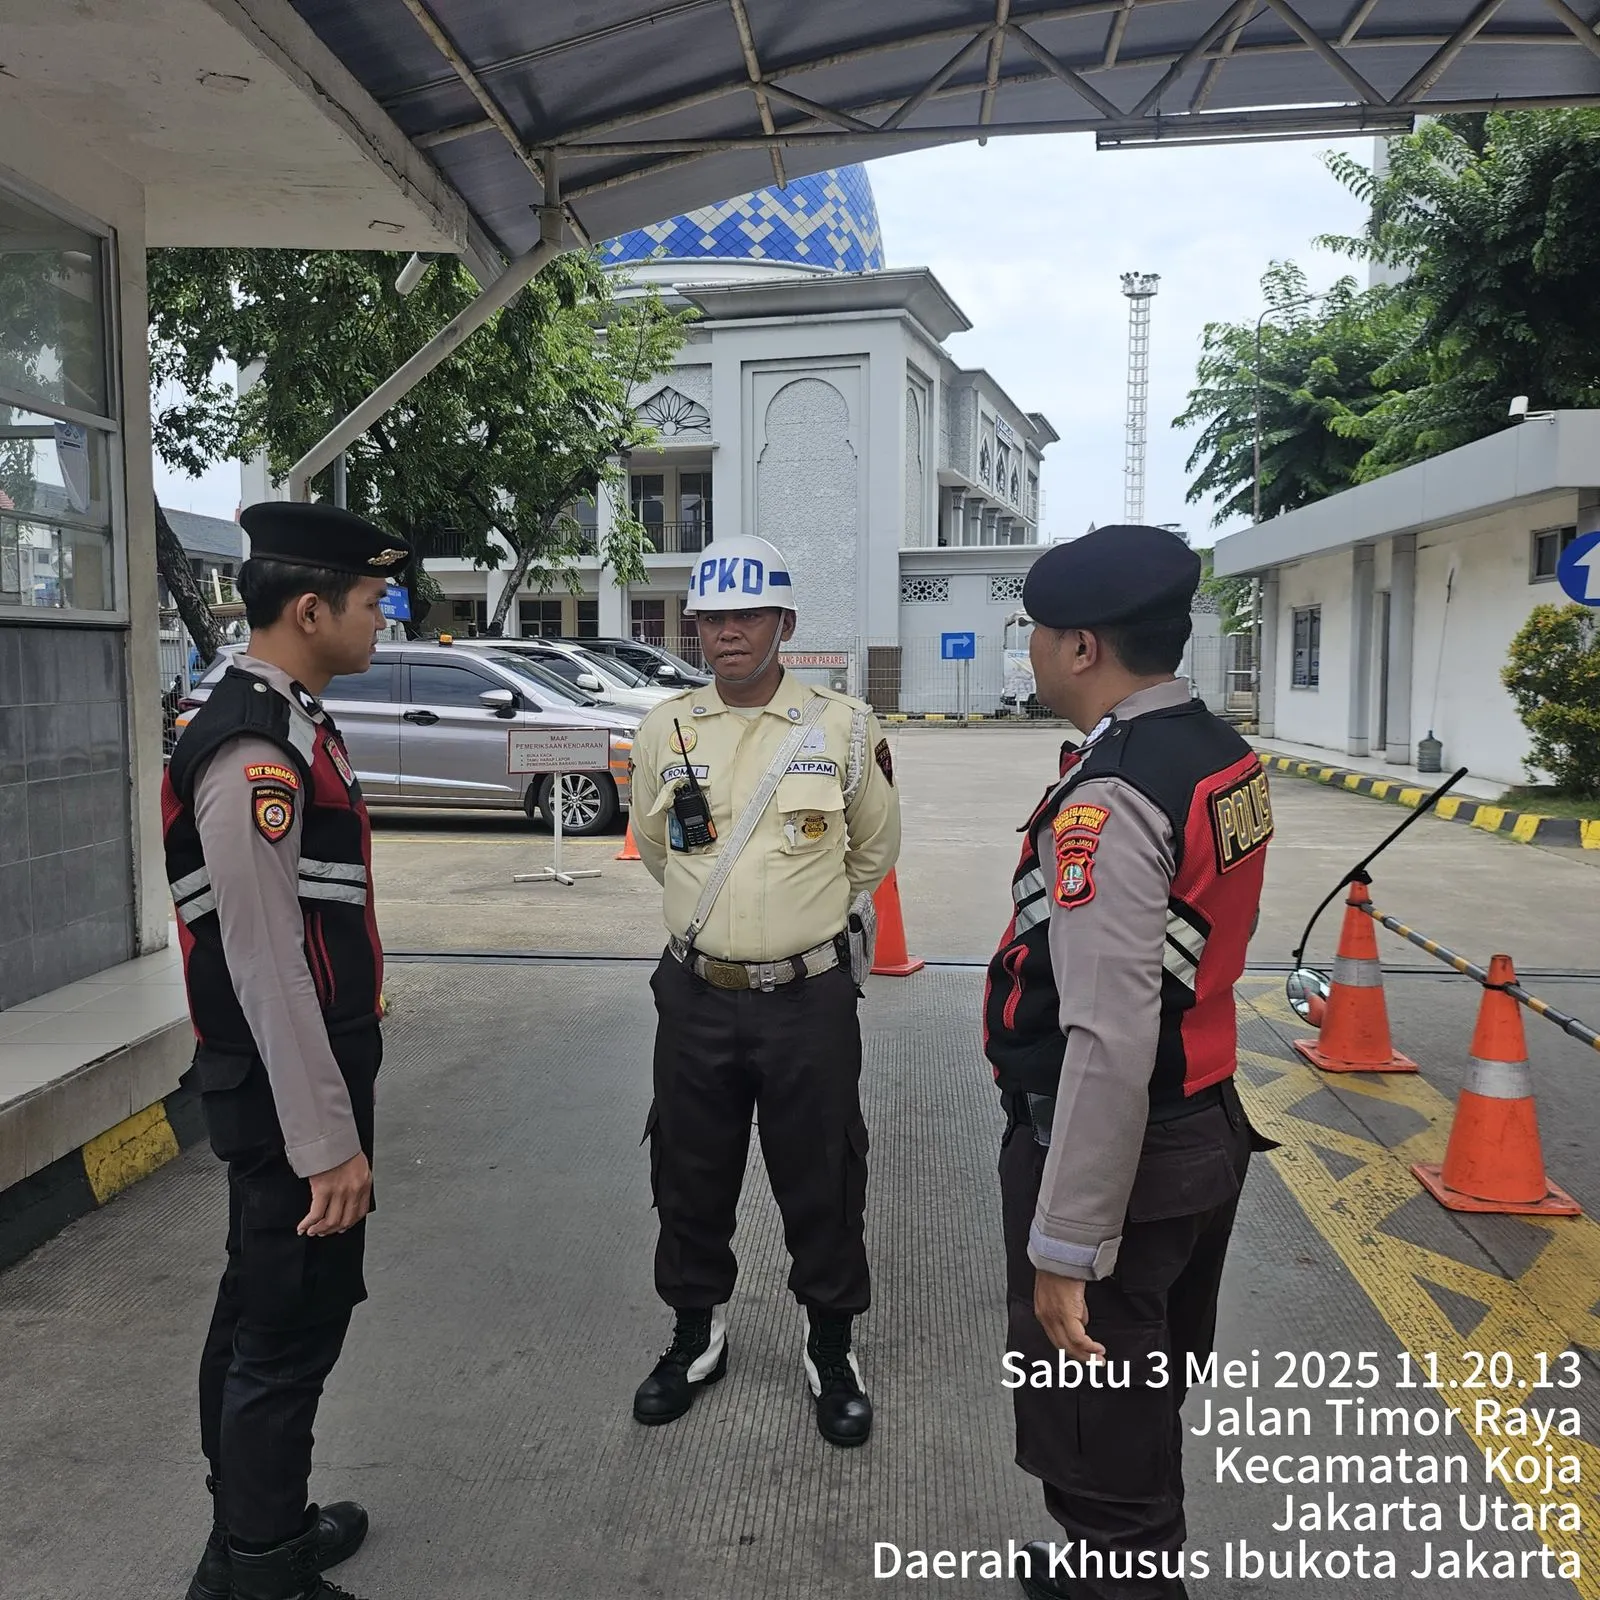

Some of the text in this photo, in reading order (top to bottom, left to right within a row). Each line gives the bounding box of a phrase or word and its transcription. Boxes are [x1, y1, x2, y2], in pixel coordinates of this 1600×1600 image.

[700, 557, 764, 597] PKD
[796, 655, 818, 665] PARKIR
[819, 655, 846, 665] PARAREL
[248, 766, 297, 785] DIT SAMAPTA
[668, 768, 699, 778] ROMI
[1077, 838, 1093, 849] JAYA
